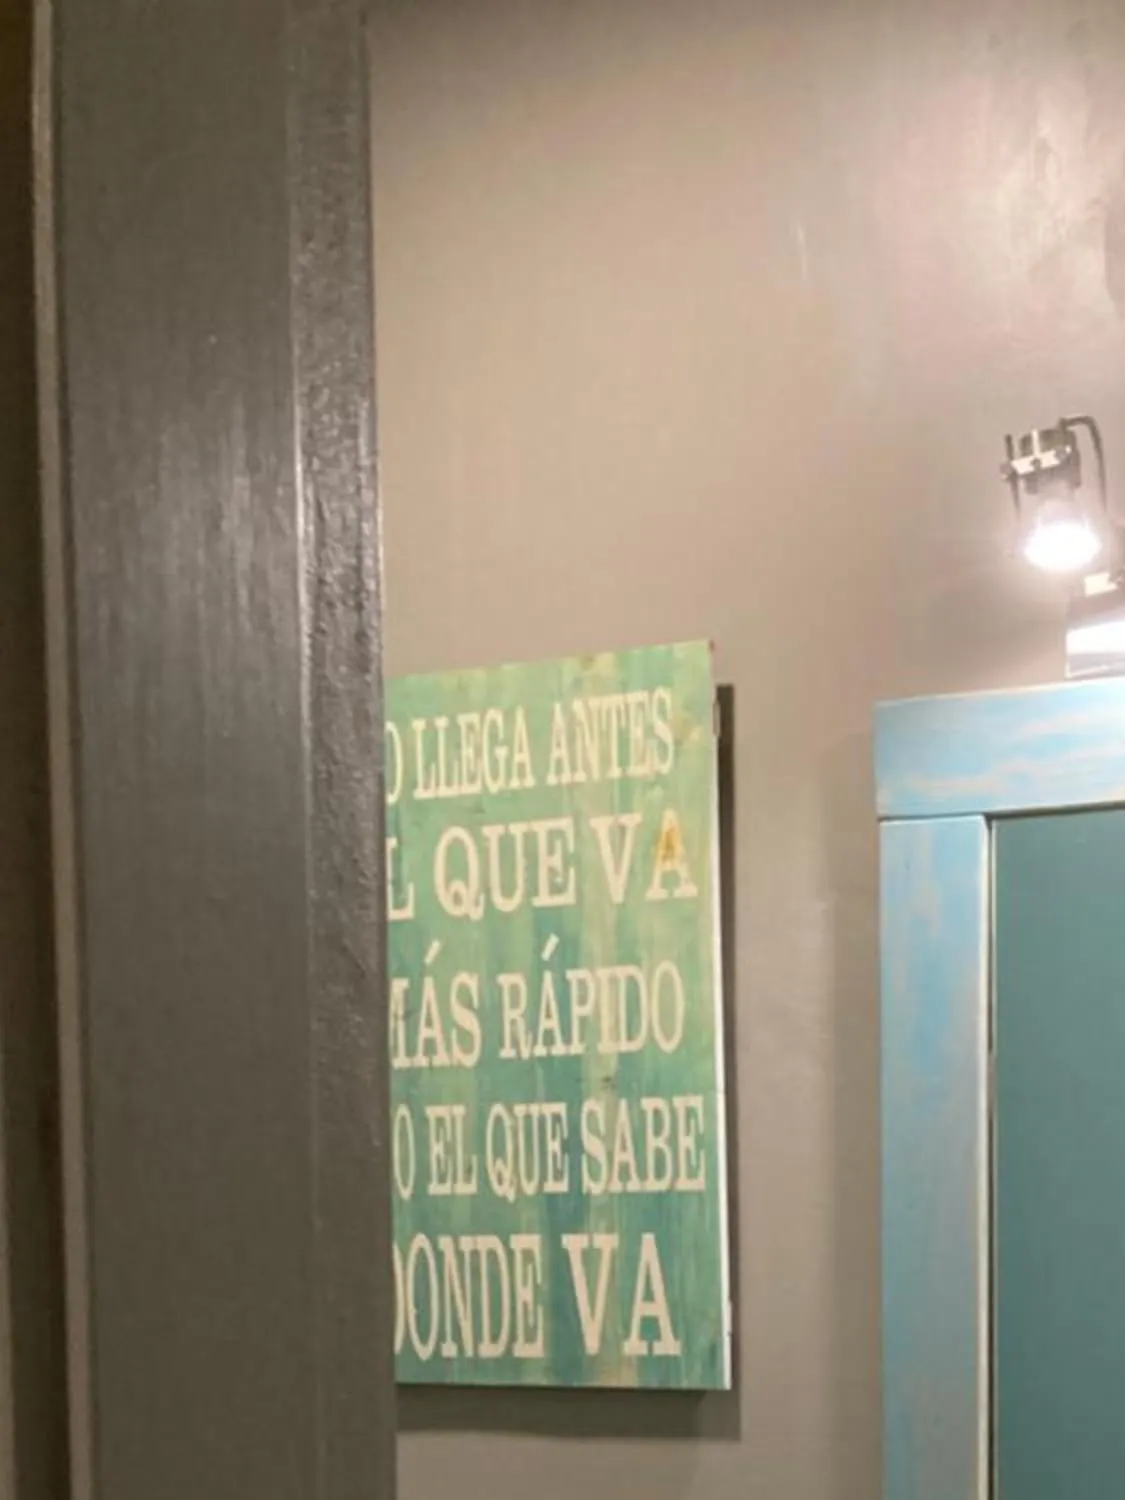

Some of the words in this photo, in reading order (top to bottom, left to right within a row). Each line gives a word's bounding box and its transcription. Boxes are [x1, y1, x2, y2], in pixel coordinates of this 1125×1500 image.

[411, 704, 536, 800] LLEGA
[546, 686, 675, 786] ANTES
[433, 817, 577, 921] QUE
[589, 808, 699, 905] VA
[496, 933, 685, 1060] RÁPIDO
[425, 1104, 478, 1196] EL
[486, 1102, 570, 1202] QUE
[580, 1095, 706, 1196] SABE
[561, 1232, 682, 1356] VA
